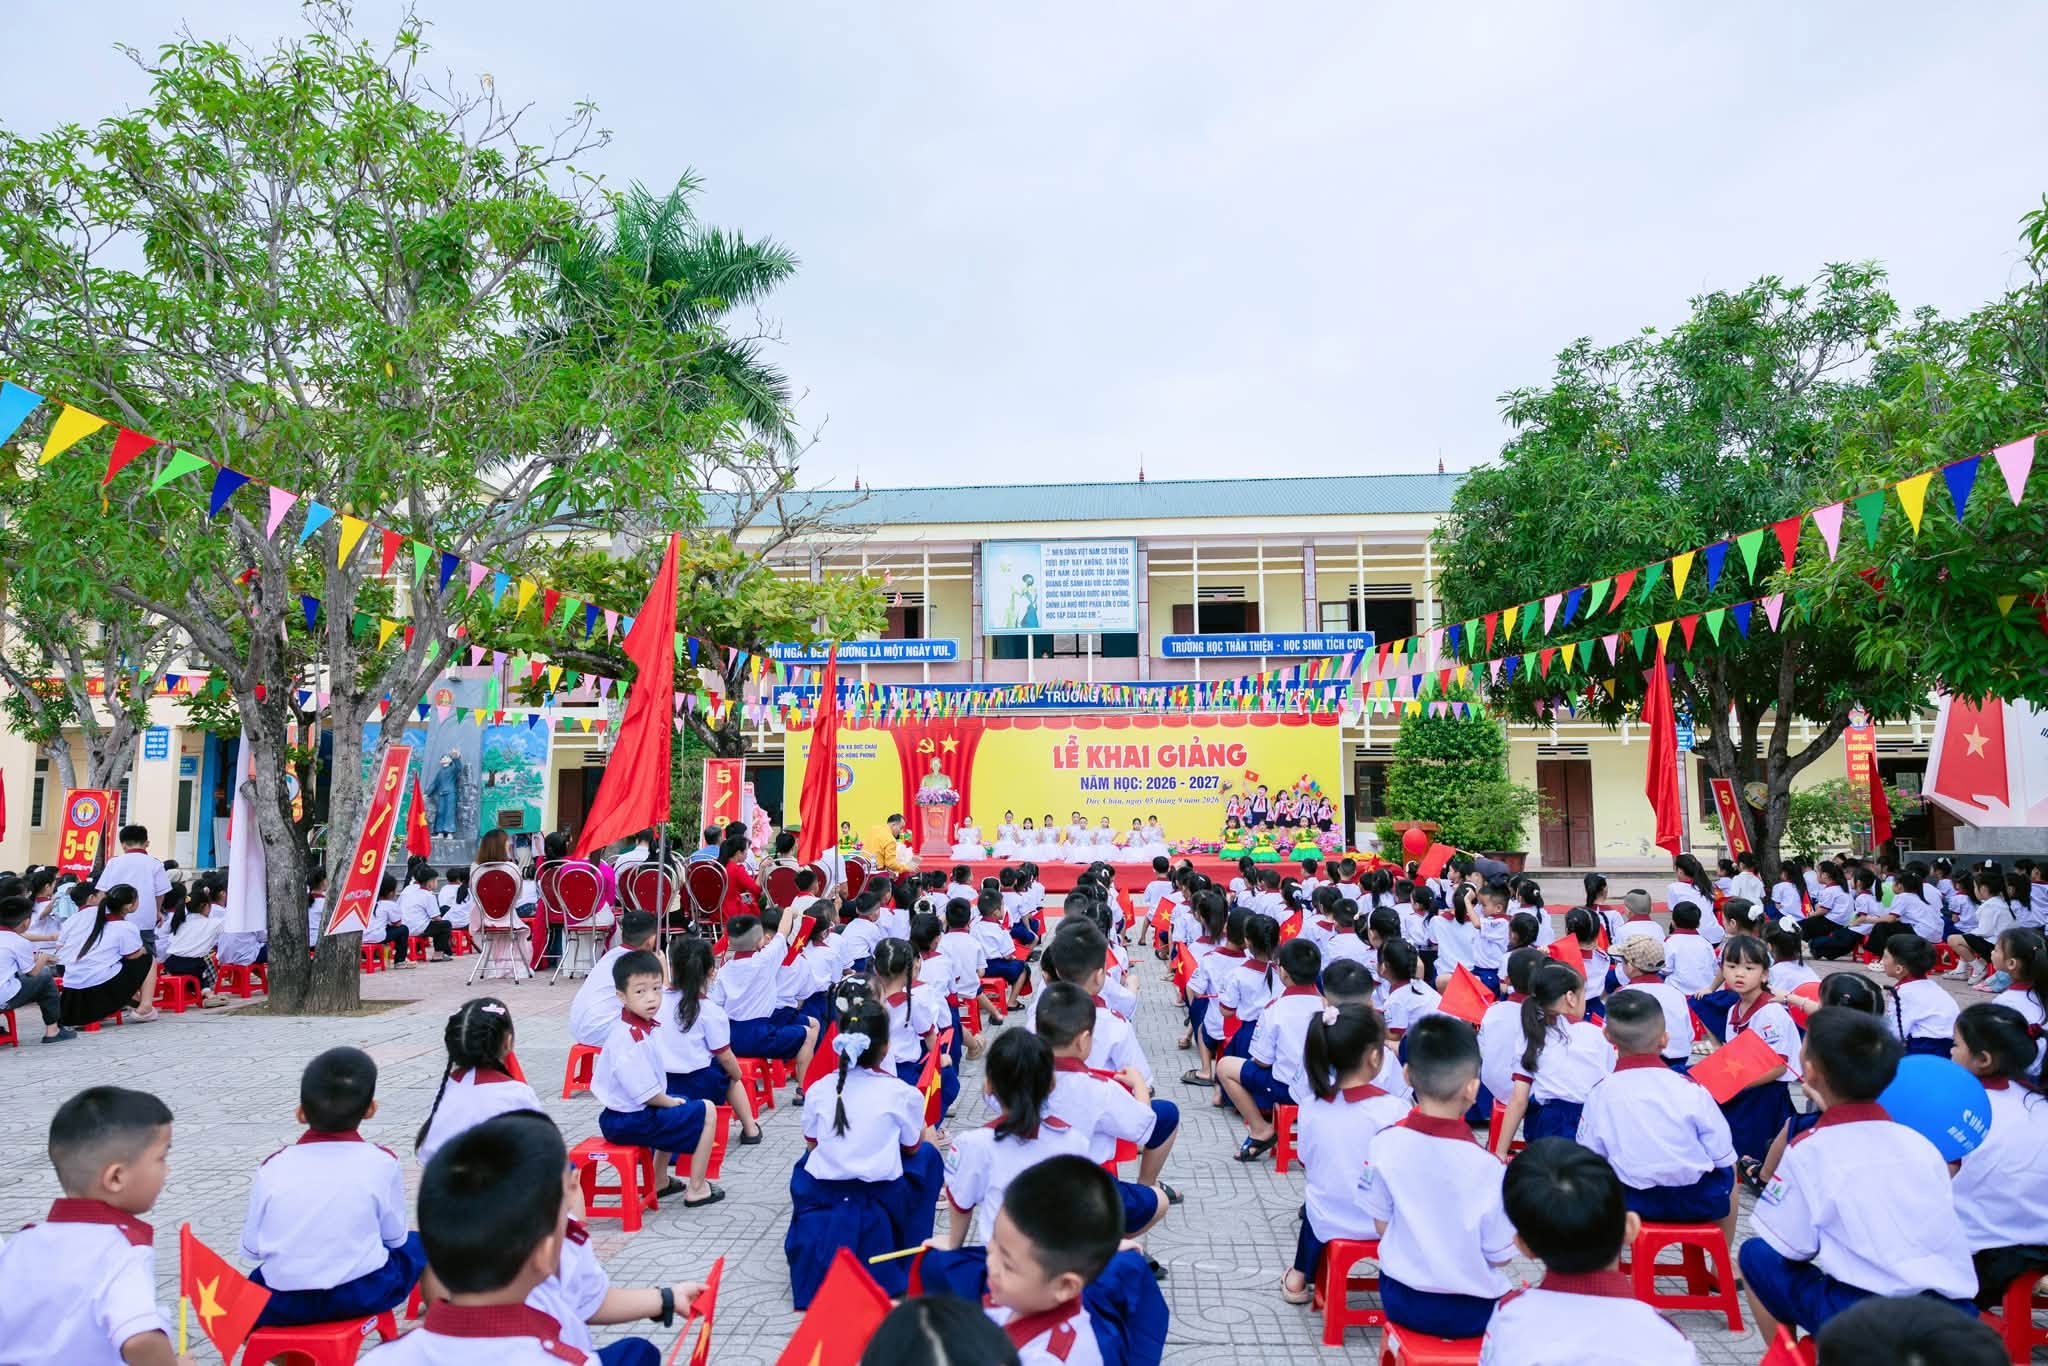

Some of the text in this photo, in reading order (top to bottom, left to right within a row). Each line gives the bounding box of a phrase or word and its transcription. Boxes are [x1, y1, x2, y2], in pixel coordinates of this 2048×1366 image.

[870, 645, 882, 657] LÀ
[884, 644, 904, 660] MỘT
[906, 643, 931, 656] NGÀY
[933, 645, 951, 656] VUI.
[1172, 637, 1204, 653] TRƯỜNG
[1206, 641, 1223, 655] HỌC
[1226, 638, 1247, 652] THÂN
[1249, 638, 1273, 654] THIỆN
[1284, 640, 1300, 653] HỌC
[1302, 639, 1322, 650] SINH
[1326, 636, 1344, 650] TÍCH
[1053, 735, 1248, 768] LỄ KHAI GIẢNG
[1080, 775, 1110, 790] NĂM
[1114, 777, 1142, 792] HỌC:
[1146, 776, 1176, 790] 2026
[1189, 776, 1220, 789] 2027
[1156, 796, 1176, 806] tháng
[1178, 796, 1183, 804] 9
[1202, 796, 1220, 804] 2026
[63, 830, 99, 860] 5-9
